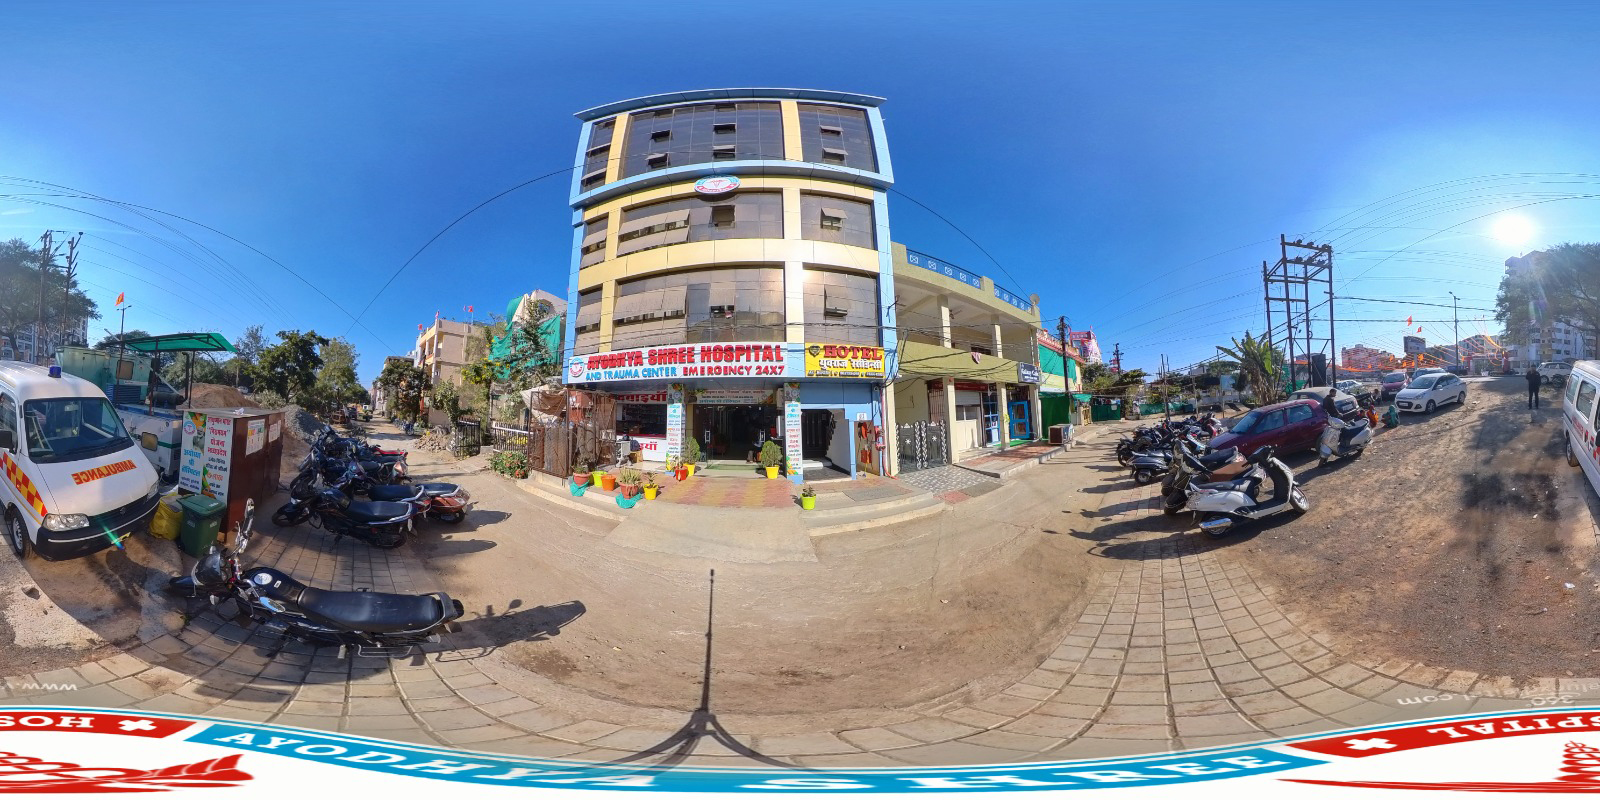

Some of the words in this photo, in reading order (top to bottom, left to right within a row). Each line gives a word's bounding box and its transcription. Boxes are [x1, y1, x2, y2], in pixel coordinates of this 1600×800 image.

[587, 350, 644, 370] AYODHYA
[648, 347, 695, 366] SHREE
[700, 345, 783, 363] HOSPITAL
[823, 345, 883, 360] HOTEL
[585, 371, 602, 381] AND
[604, 368, 640, 379] TRAUMA
[642, 366, 677, 378] CENTER
[683, 365, 752, 376] EMERGENCY
[755, 365, 785, 376] 24X7
